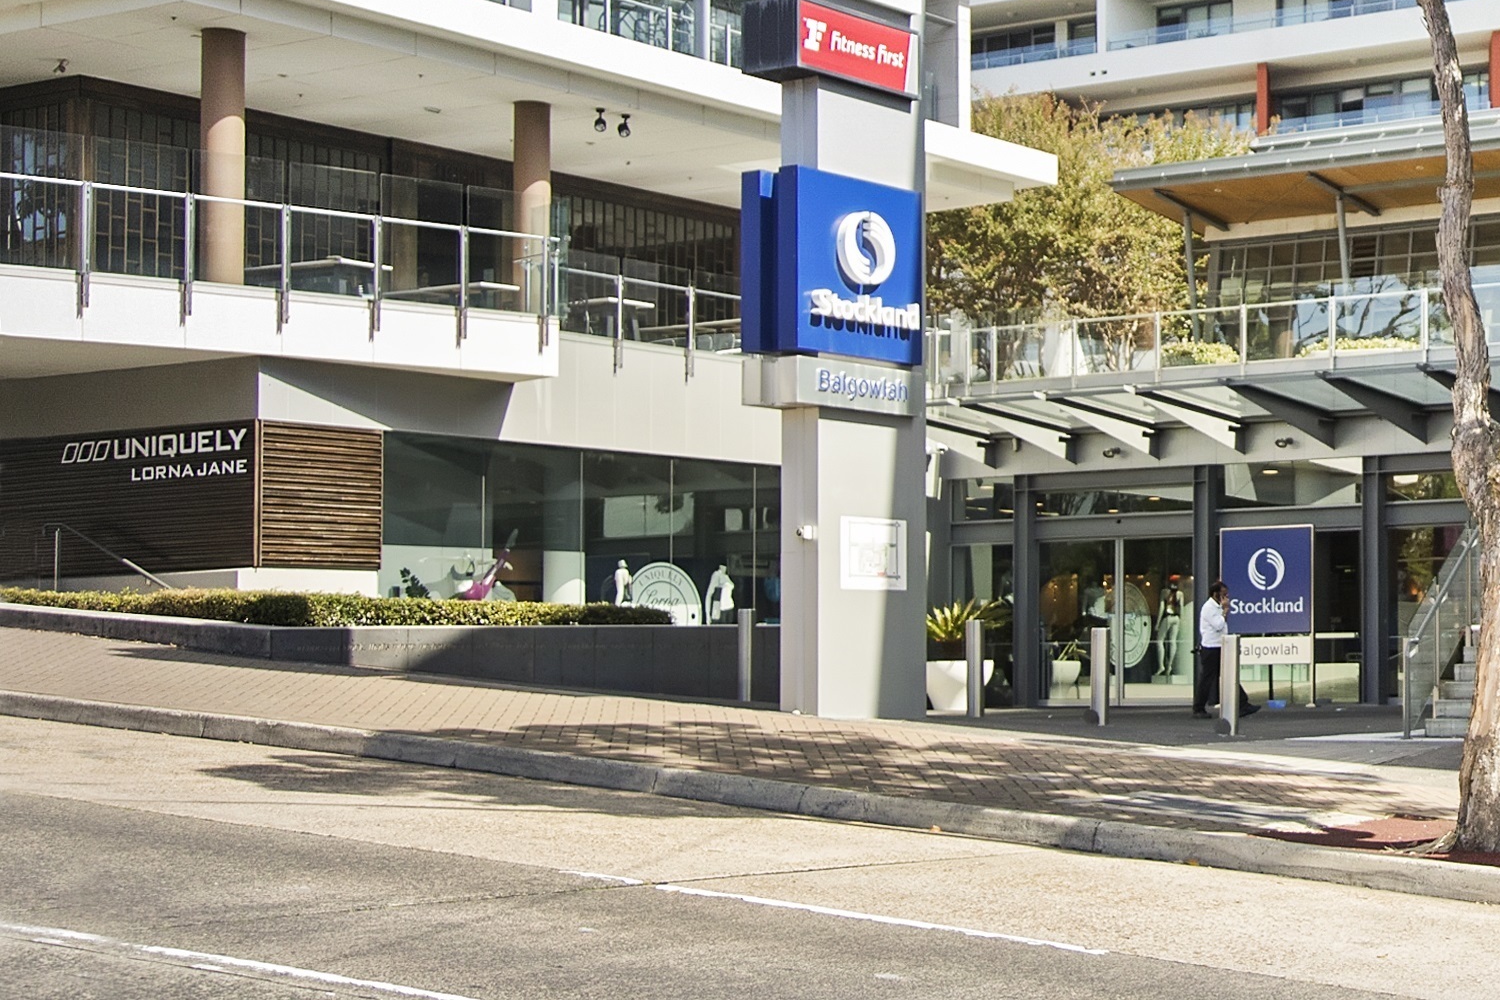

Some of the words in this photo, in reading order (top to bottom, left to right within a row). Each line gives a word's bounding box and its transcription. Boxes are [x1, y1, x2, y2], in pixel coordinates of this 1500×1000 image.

[810, 288, 920, 331] Stockland
[816, 367, 909, 402] Balgowlah
[113, 428, 247, 460] UNIQUELY
[131, 463, 194, 481] LORNA
[197, 459, 247, 477] JANE
[1230, 597, 1304, 615] Stockland
